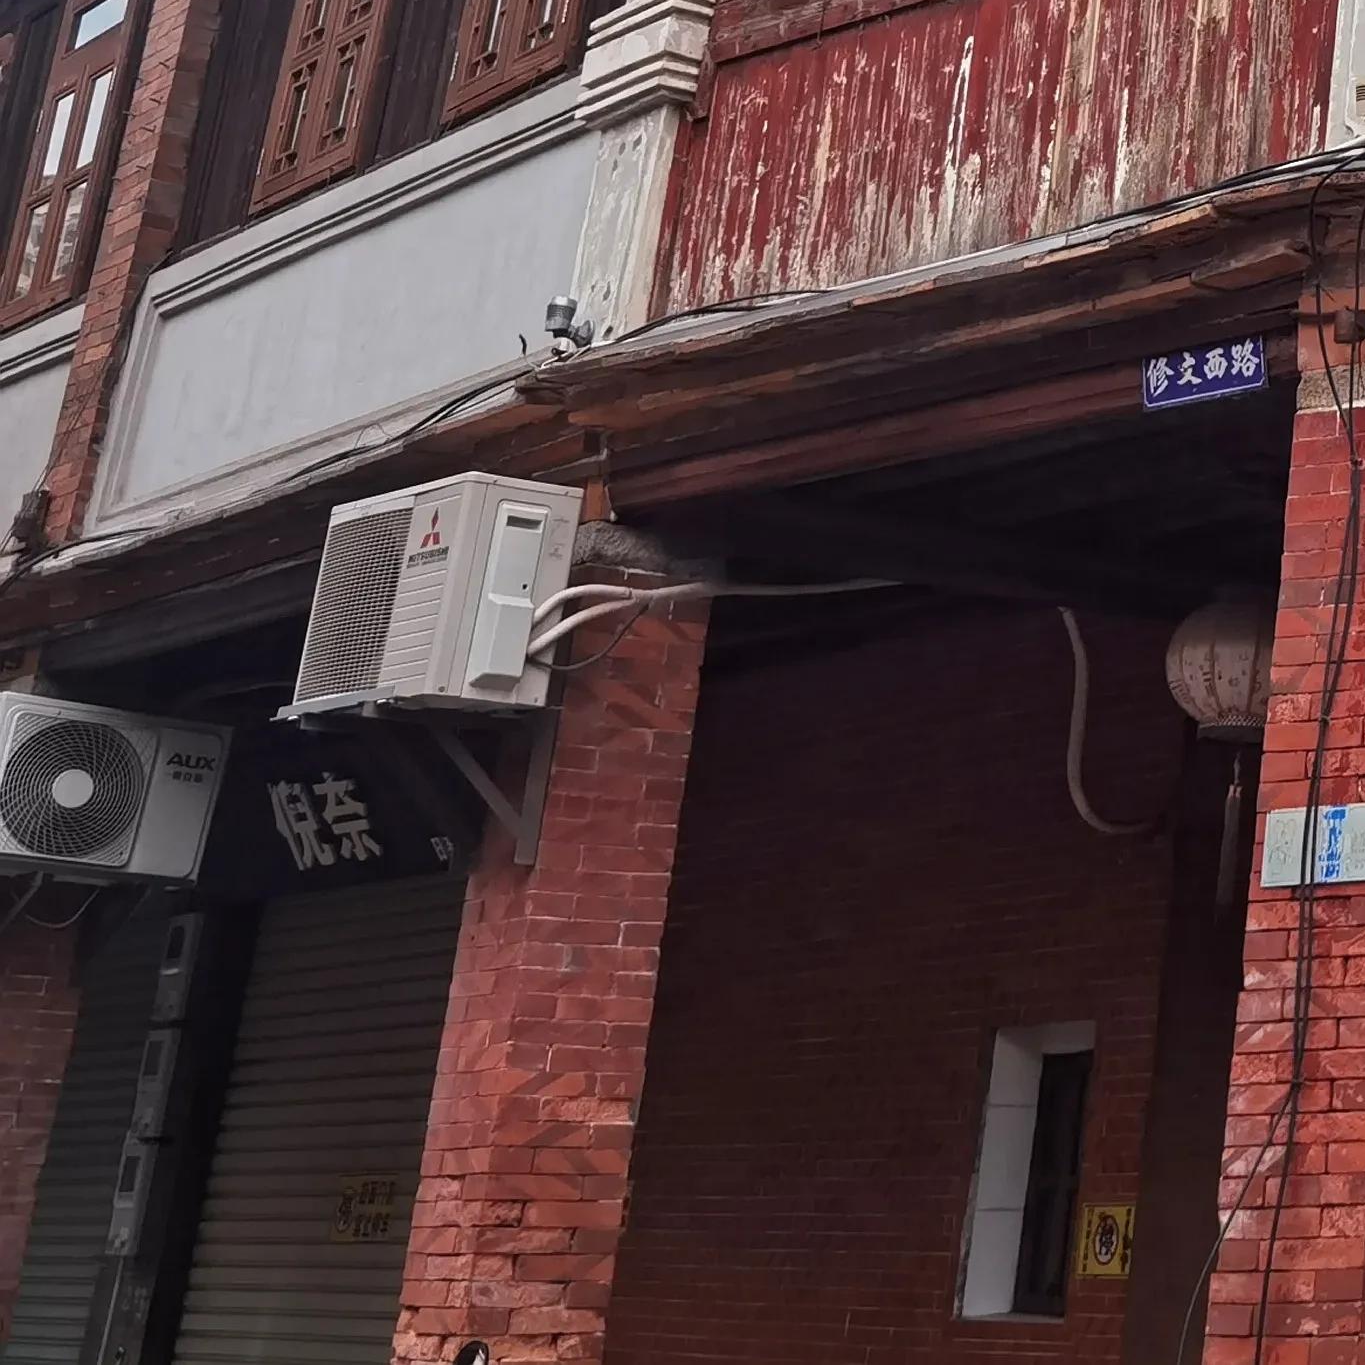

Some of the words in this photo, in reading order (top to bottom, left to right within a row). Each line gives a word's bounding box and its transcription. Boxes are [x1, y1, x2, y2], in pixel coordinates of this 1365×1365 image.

[1147, 338, 1260, 397] 修文西路
[167, 753, 216, 771] AUX
